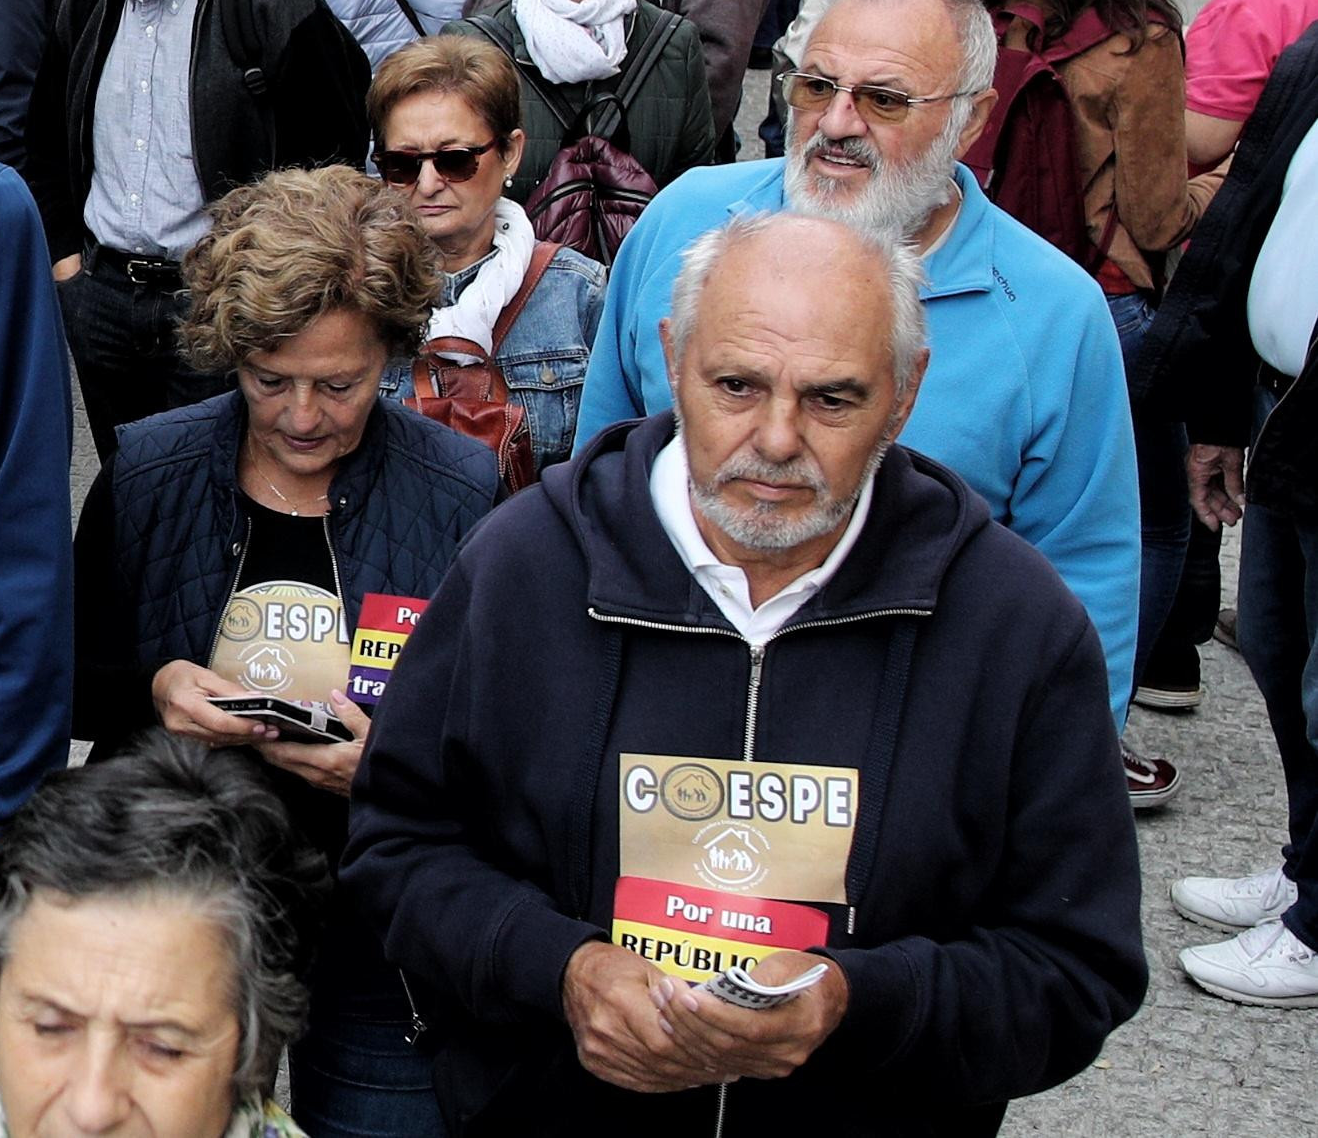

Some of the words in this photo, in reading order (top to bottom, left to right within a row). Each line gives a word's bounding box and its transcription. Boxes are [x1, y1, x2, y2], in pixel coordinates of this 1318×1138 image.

[666, 894, 713, 924] Por
[721, 910, 771, 935] una
[621, 932, 759, 976] REPÚBLIC
